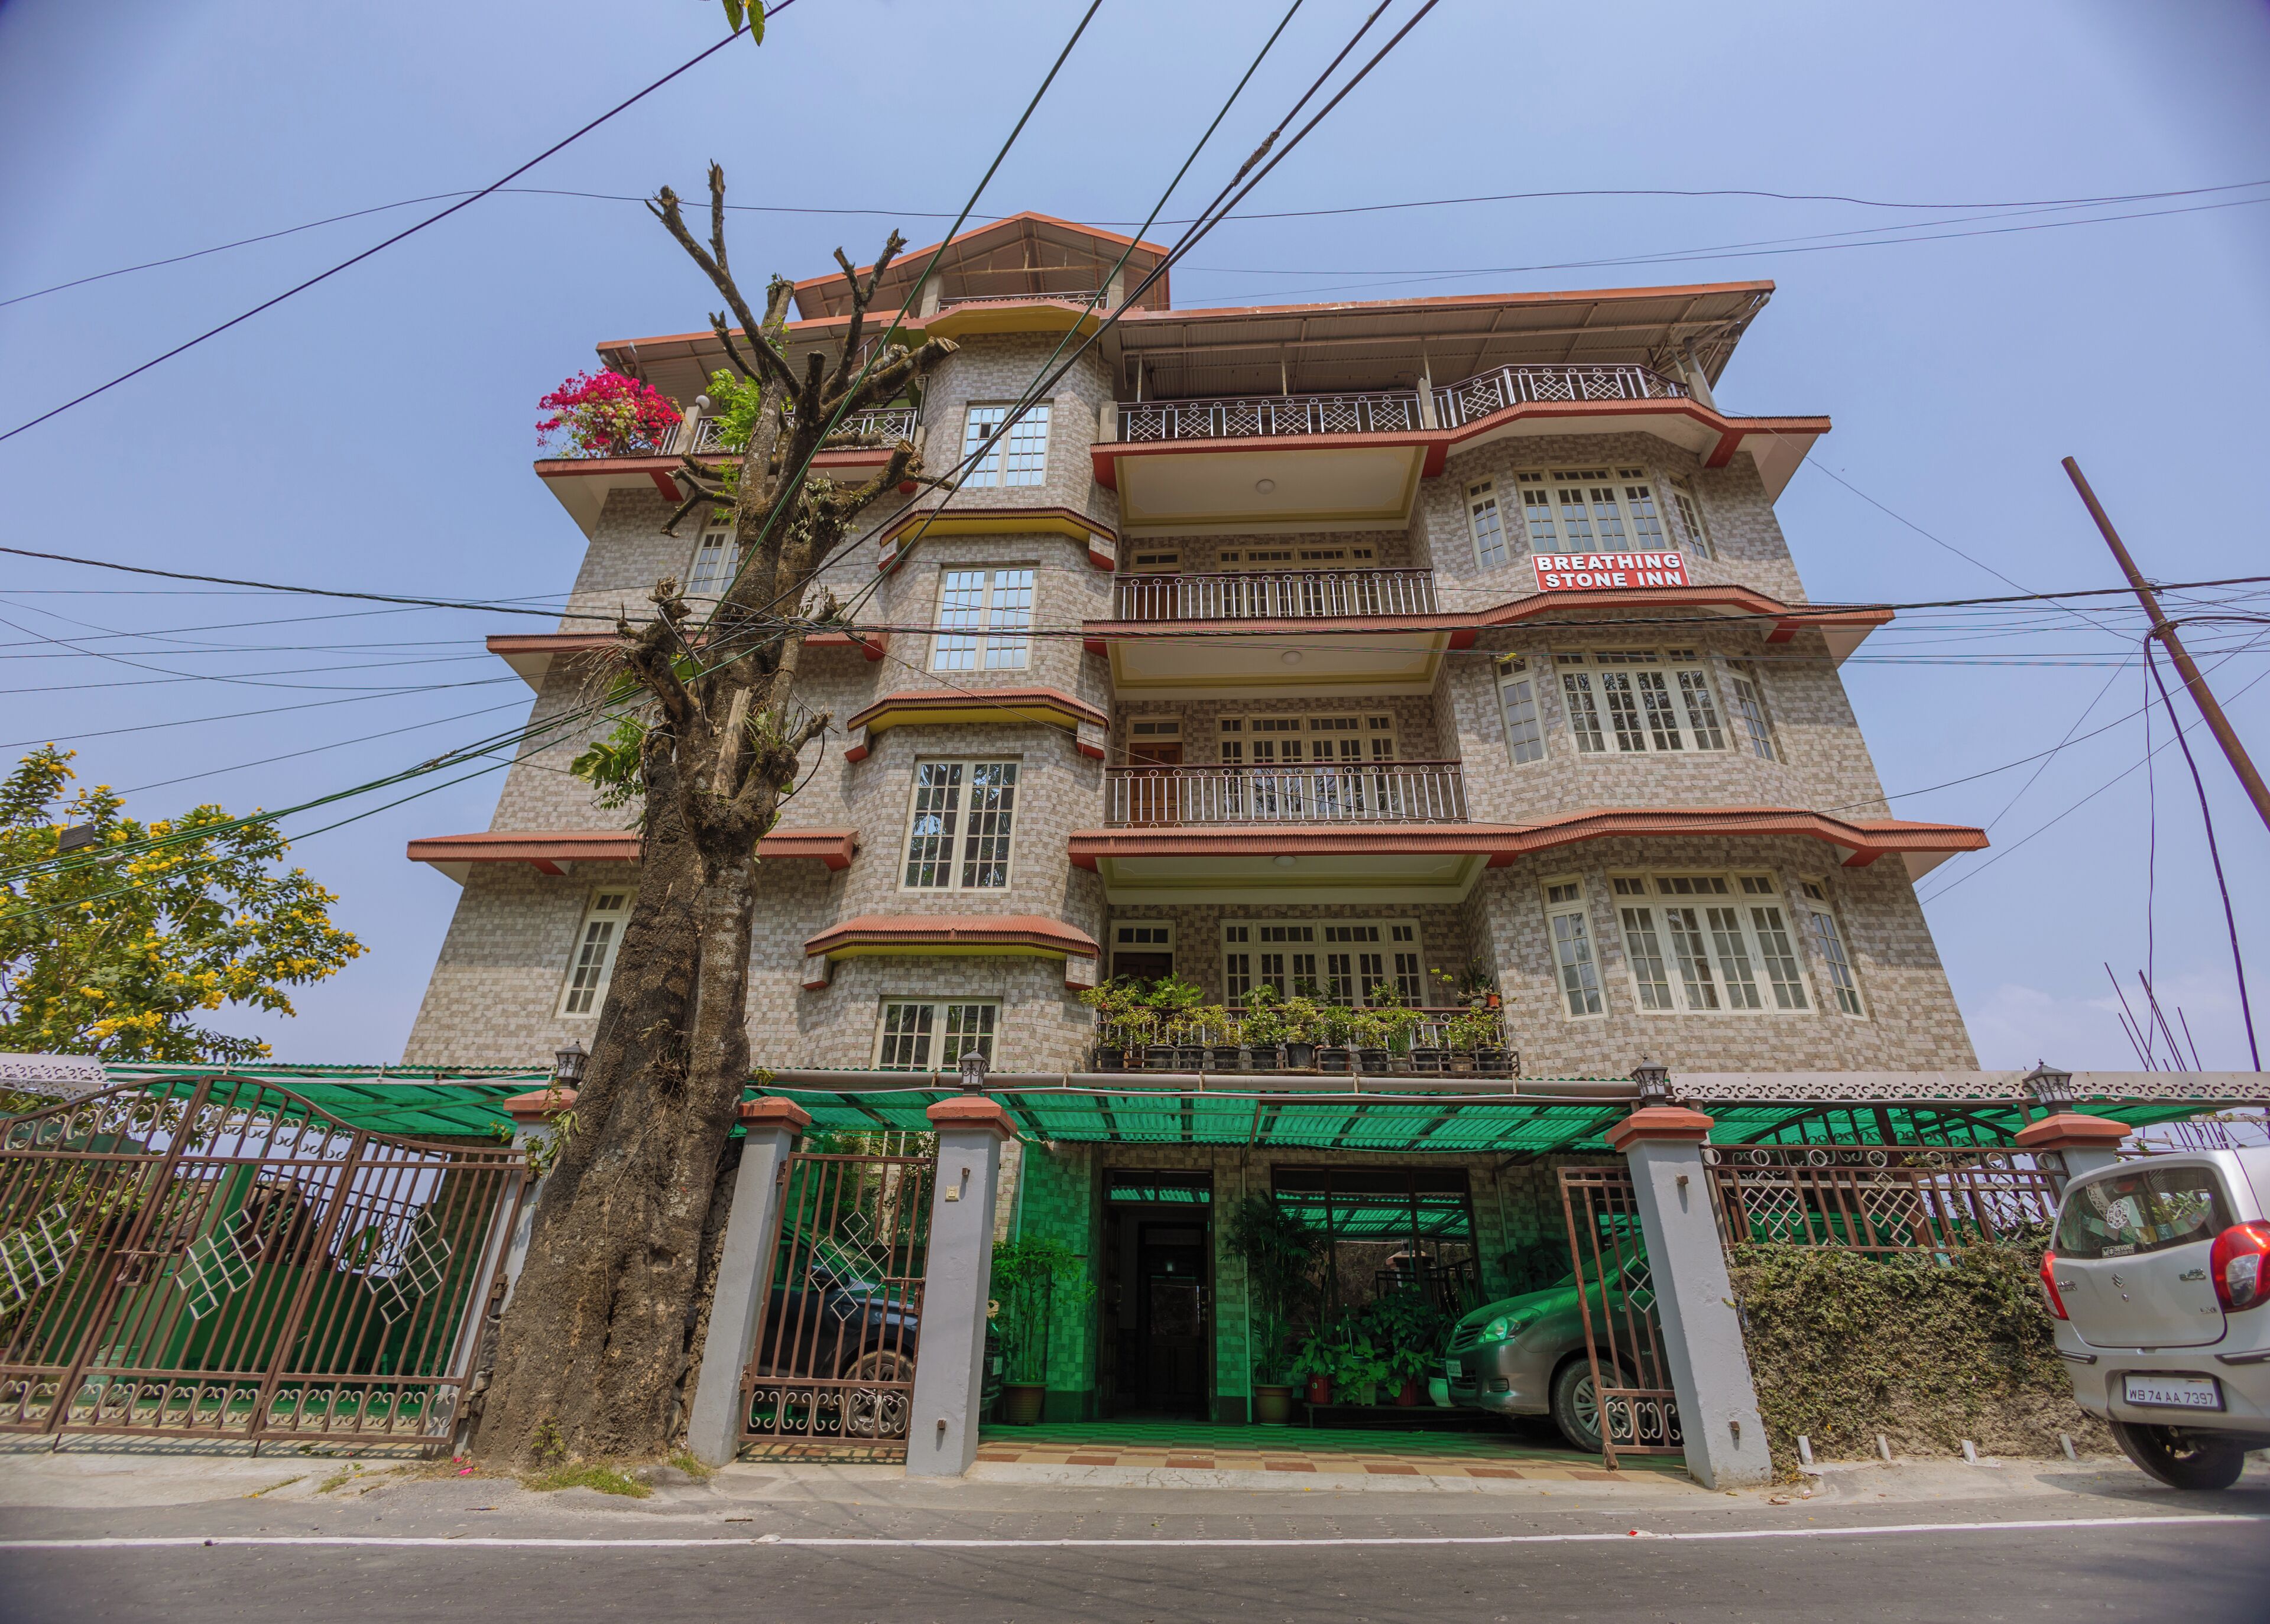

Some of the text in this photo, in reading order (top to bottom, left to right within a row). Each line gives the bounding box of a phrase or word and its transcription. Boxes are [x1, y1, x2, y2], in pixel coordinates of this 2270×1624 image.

[1537, 554, 1681, 571] BREATHING
[1545, 571, 1682, 588] STONE INN
[2129, 1389, 2213, 1404] WB 74 AA 7397
